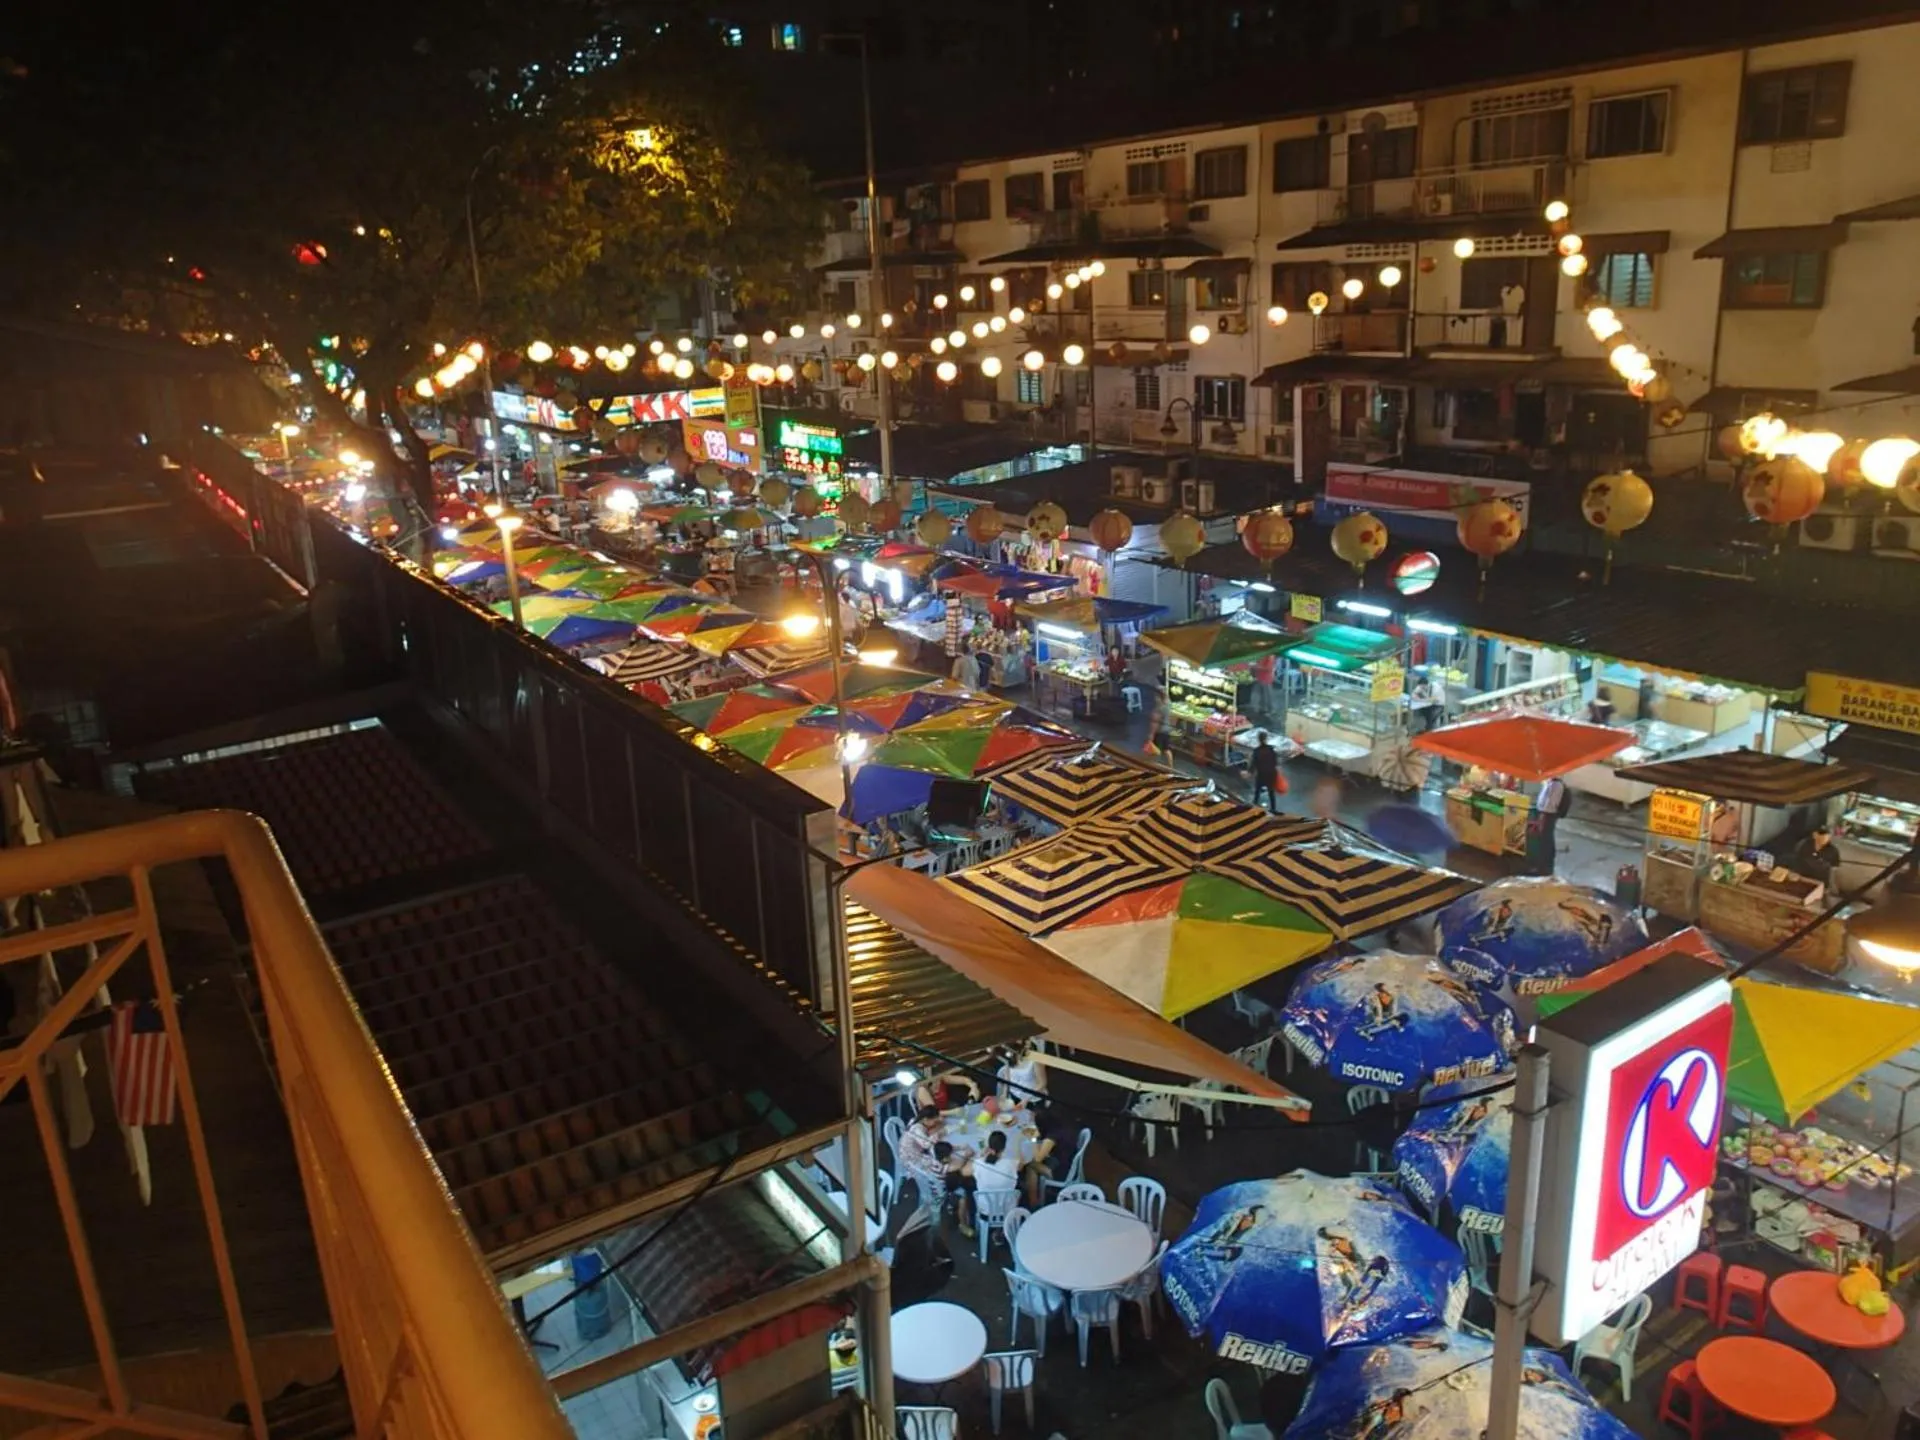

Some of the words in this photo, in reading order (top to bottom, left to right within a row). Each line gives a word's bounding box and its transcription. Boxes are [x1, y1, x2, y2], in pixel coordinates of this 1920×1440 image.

[632, 391, 688, 422] KK
[1840, 706, 1904, 727] MAKANAN
[1342, 1062, 1404, 1086] ISOTONIC
[1399, 1160, 1435, 1204] ISOTONIC
[1460, 1205, 1505, 1233] Rev
[1218, 1332, 1312, 1375] Revive
